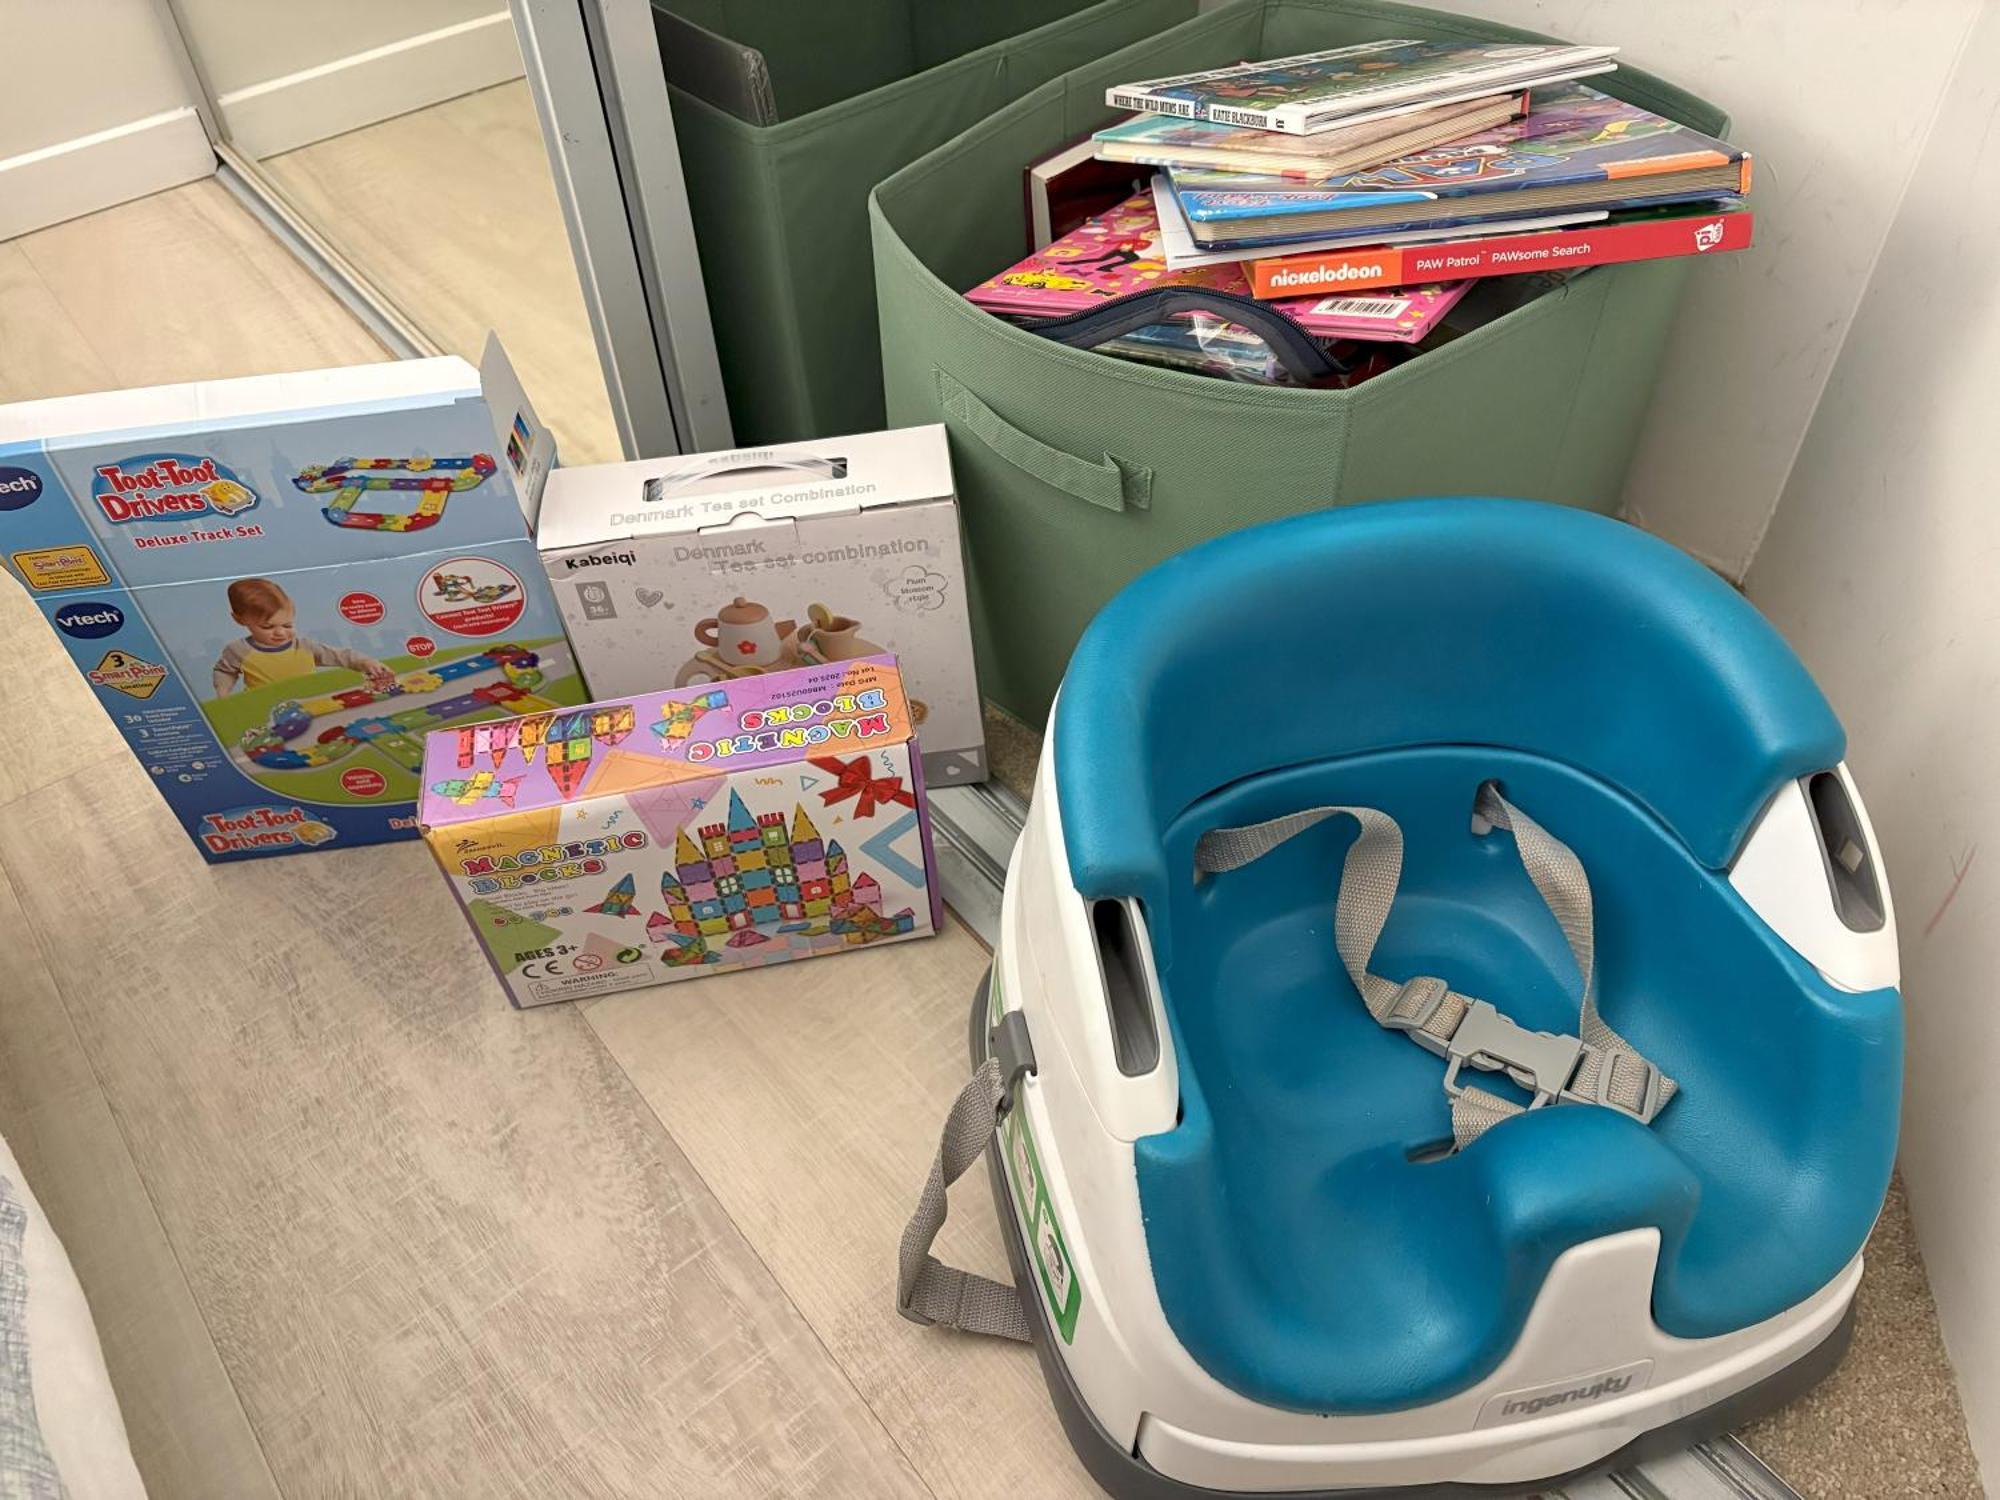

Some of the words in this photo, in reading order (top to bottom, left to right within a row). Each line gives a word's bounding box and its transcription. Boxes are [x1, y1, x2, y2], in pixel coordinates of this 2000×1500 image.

[1113, 95, 1132, 107] WHERE
[1133, 97, 1144, 109] THE
[1144, 99, 1159, 111] WILD
[1178, 104, 1190, 116] ARE
[1212, 109, 1231, 122] KATIE
[1231, 112, 1268, 128] BLACKBURN
[1416, 257, 1444, 272] PAW
[1491, 249, 1549, 264] PAWsome
[1551, 243, 1591, 258] Search
[1270, 263, 1383, 287] nickelodeon
[0, 476, 37, 494] ech
[98, 459, 220, 493] Toot-Toot
[97, 491, 207, 522] Drivers
[610, 505, 694, 526] Denmark
[702, 501, 732, 514] Tea
[739, 495, 765, 507] set
[771, 482, 877, 505] Combination
[135, 534, 189, 550] Deluxe
[191, 527, 233, 543] Track
[237, 524, 263, 537] Set
[565, 551, 637, 570] Kabeiqi
[673, 539, 766, 562] Denmark
[802, 538, 929, 567] combination
[57, 611, 120, 627] vtech
[409, 642, 433, 652] STOP
[111, 655, 124, 668] 3
[742, 689, 886, 731] BLOCKS
[689, 711, 889, 763] MAGNETIC
[205, 808, 305, 832] Toot-Toot
[204, 830, 293, 853] Drivers
[462, 831, 647, 877] MAGNETIC
[469, 858, 606, 895] BLOCKS
[514, 948, 555, 963] AGES
[556, 944, 579, 957] 3+
[1502, 1374, 1633, 1417] ingenuity
